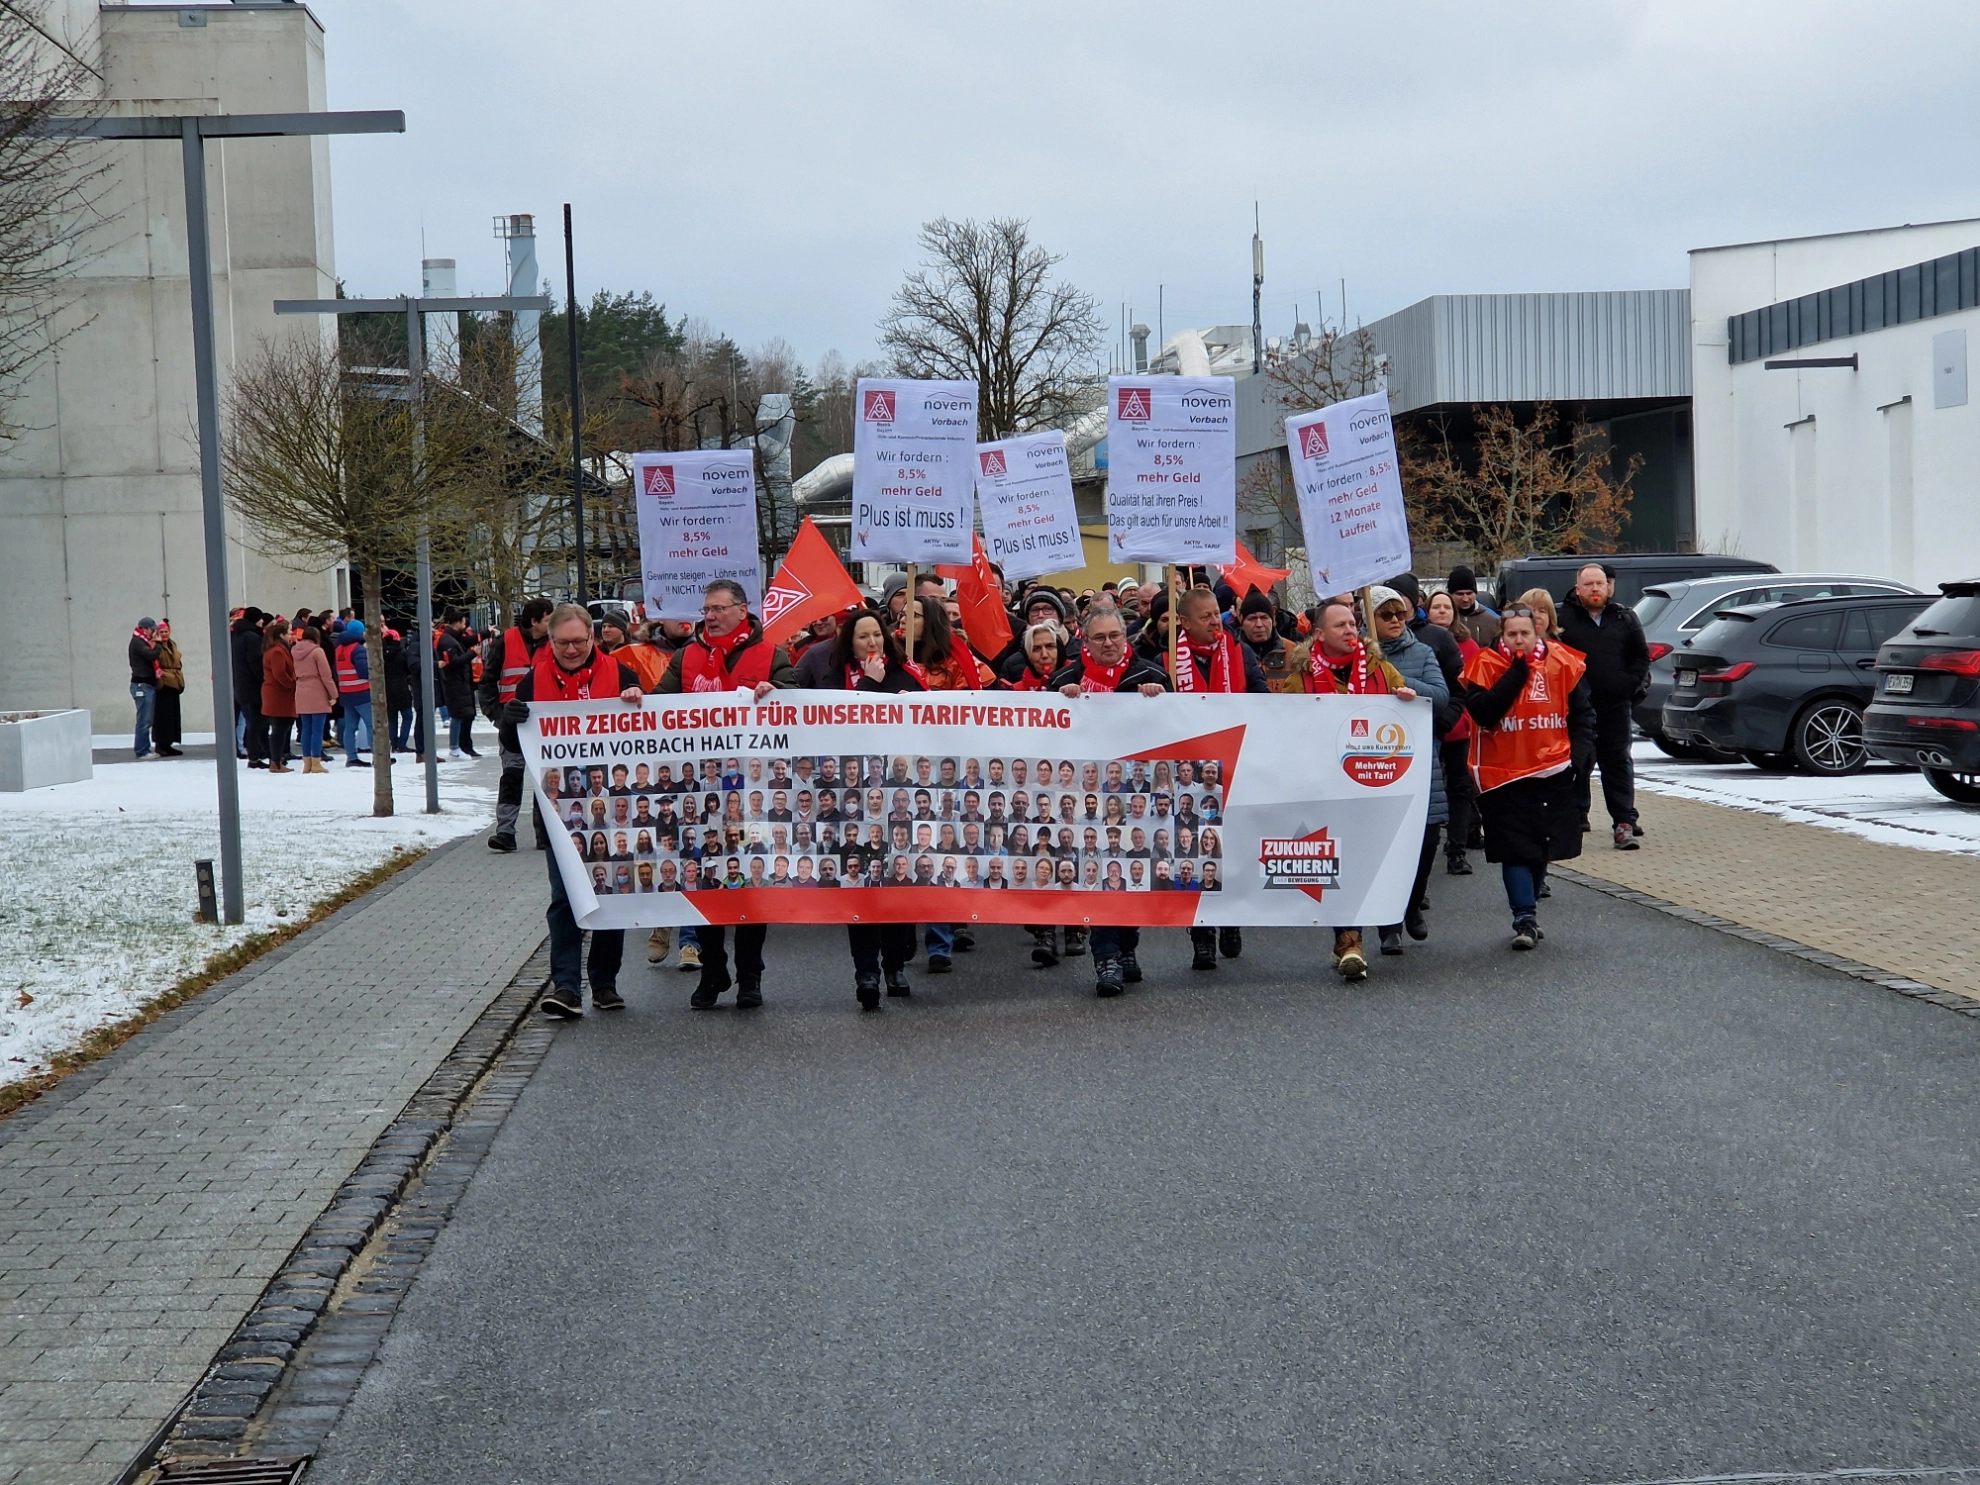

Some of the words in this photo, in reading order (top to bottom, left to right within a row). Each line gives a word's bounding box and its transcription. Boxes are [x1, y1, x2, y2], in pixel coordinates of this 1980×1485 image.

[924, 400, 972, 411] novem
[1181, 397, 1231, 408] novem
[931, 417, 969, 426] Vorbach
[1189, 415, 1228, 424] Vorbach
[1349, 412, 1390, 432] novem
[1136, 439, 1154, 448] Wir
[1157, 438, 1195, 448] fordern
[1359, 430, 1389, 445] Vorbach
[876, 451, 896, 462] Wir
[900, 451, 942, 462] fordern
[1027, 446, 1064, 459] novem
[1035, 459, 1063, 469] Vorbach
[1154, 454, 1184, 466] 8,5%
[702, 469, 750, 481] novem
[898, 469, 926, 480] 8,5%
[1136, 472, 1169, 483] mehr
[1172, 472, 1201, 483] Geld
[1306, 482, 1324, 495] Wir
[1326, 471, 1362, 489] fordern
[1369, 461, 1391, 477] 8,5%
[711, 486, 748, 495] Vorbach
[881, 486, 912, 496] mehr
[915, 486, 942, 497] Geld
[1328, 492, 1353, 507] mehr
[1355, 482, 1378, 499] Geld
[997, 494, 1015, 505] Wir
[1016, 489, 1050, 501] fordern
[1109, 493, 1140, 507] Qualität
[1141, 494, 1155, 507] hat
[1156, 494, 1176, 507] ihren
[1178, 494, 1199, 508] Preis
[1018, 503, 1040, 515] 8,5%
[1330, 512, 1342, 524] 12
[1344, 501, 1381, 521] Monate
[659, 517, 679, 527] Wir
[683, 515, 725, 526] fordern
[859, 504, 890, 527] Plus
[895, 505, 911, 527] ist
[916, 511, 955, 528] muss
[1007, 518, 1031, 529] mehr
[1033, 514, 1055, 525] Geld
[1109, 513, 1126, 527] Das
[1127, 514, 1139, 530] gilt
[1140, 513, 1160, 527] auch
[1161, 513, 1173, 527] für
[1174, 516, 1196, 528] unsre
[1198, 514, 1221, 528] Arbeit
[1339, 519, 1377, 539] Laufzeit
[683, 532, 711, 543] 8,5%
[993, 538, 1020, 556] Plus
[1021, 533, 1036, 551] ist
[1039, 530, 1069, 548] muss
[669, 548, 698, 558] mehr
[701, 546, 728, 557] Geld
[646, 570, 678, 581] Gewinne
[679, 569, 706, 582] steigen
[714, 568, 737, 579] Löhne
[738, 567, 757, 577] nicht
[671, 584, 696, 595] NICHT
[538, 716, 581, 737] WIR
[585, 711, 657, 735] ZEIGEN
[661, 706, 751, 731] GESICHT
[755, 700, 798, 727] FÜR
[802, 704, 904, 726] UNSEREN
[908, 704, 1071, 729] TARIFVERTRAG
[1500, 715, 1525, 732] Wir
[540, 741, 605, 760] NOVEM
[609, 736, 695, 756] VORBACH
[700, 733, 743, 751] HALT
[747, 733, 789, 750] ZAM
[1354, 761, 1397, 770] MehrWert
[1357, 771, 1372, 780] mit
[1373, 771, 1394, 780] Tarif
[1264, 841, 1332, 856] ZUKUNFT
[1267, 859, 1338, 874] SICHERN.
